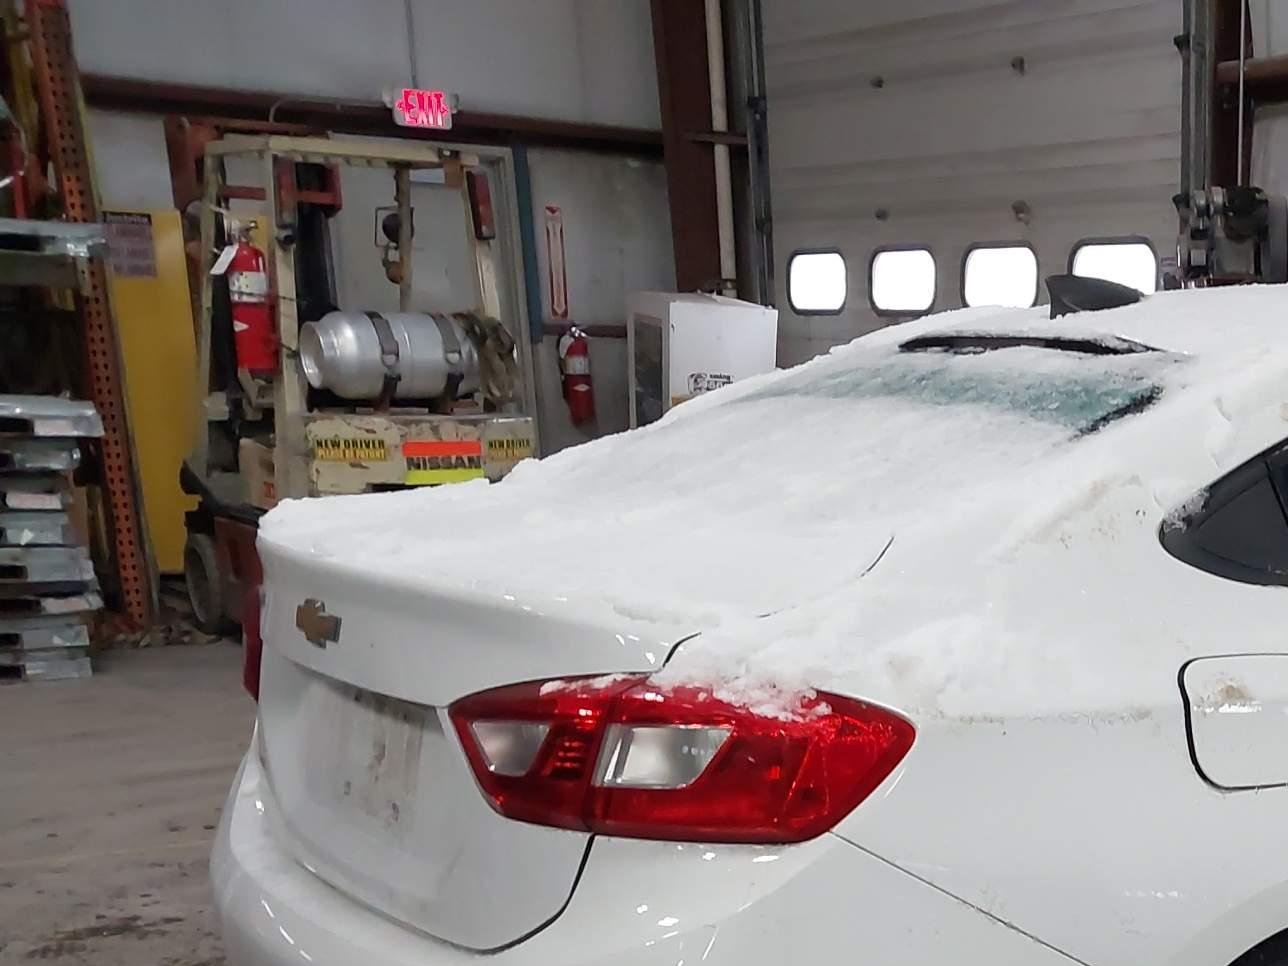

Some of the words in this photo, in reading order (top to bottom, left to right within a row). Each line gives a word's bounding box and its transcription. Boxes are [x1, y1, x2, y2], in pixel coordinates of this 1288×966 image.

[403, 89, 444, 127] EXIT
[316, 439, 341, 449] NEW
[343, 439, 385, 449] DRIVER
[406, 456, 481, 471] NISSAN
